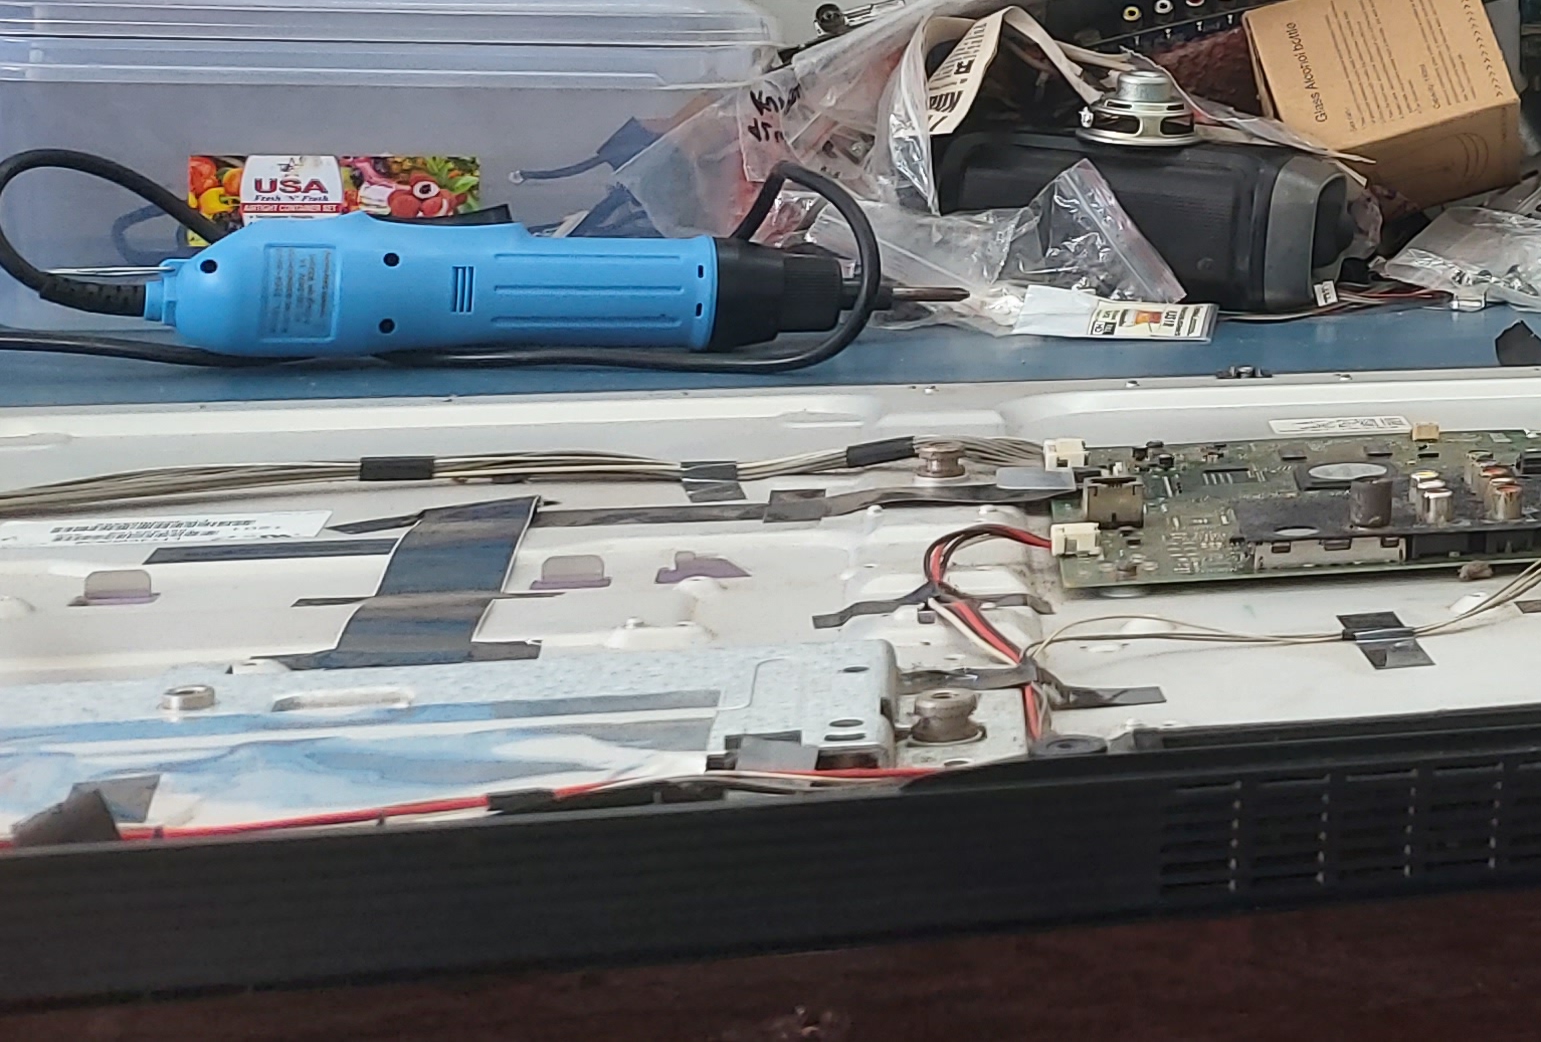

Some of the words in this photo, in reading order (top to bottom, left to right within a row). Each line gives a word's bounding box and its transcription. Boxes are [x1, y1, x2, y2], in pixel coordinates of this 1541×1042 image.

[1293, 52, 1319, 90] Alcohol
[1309, 91, 1328, 123] Glass
[254, 177, 329, 194] USA
